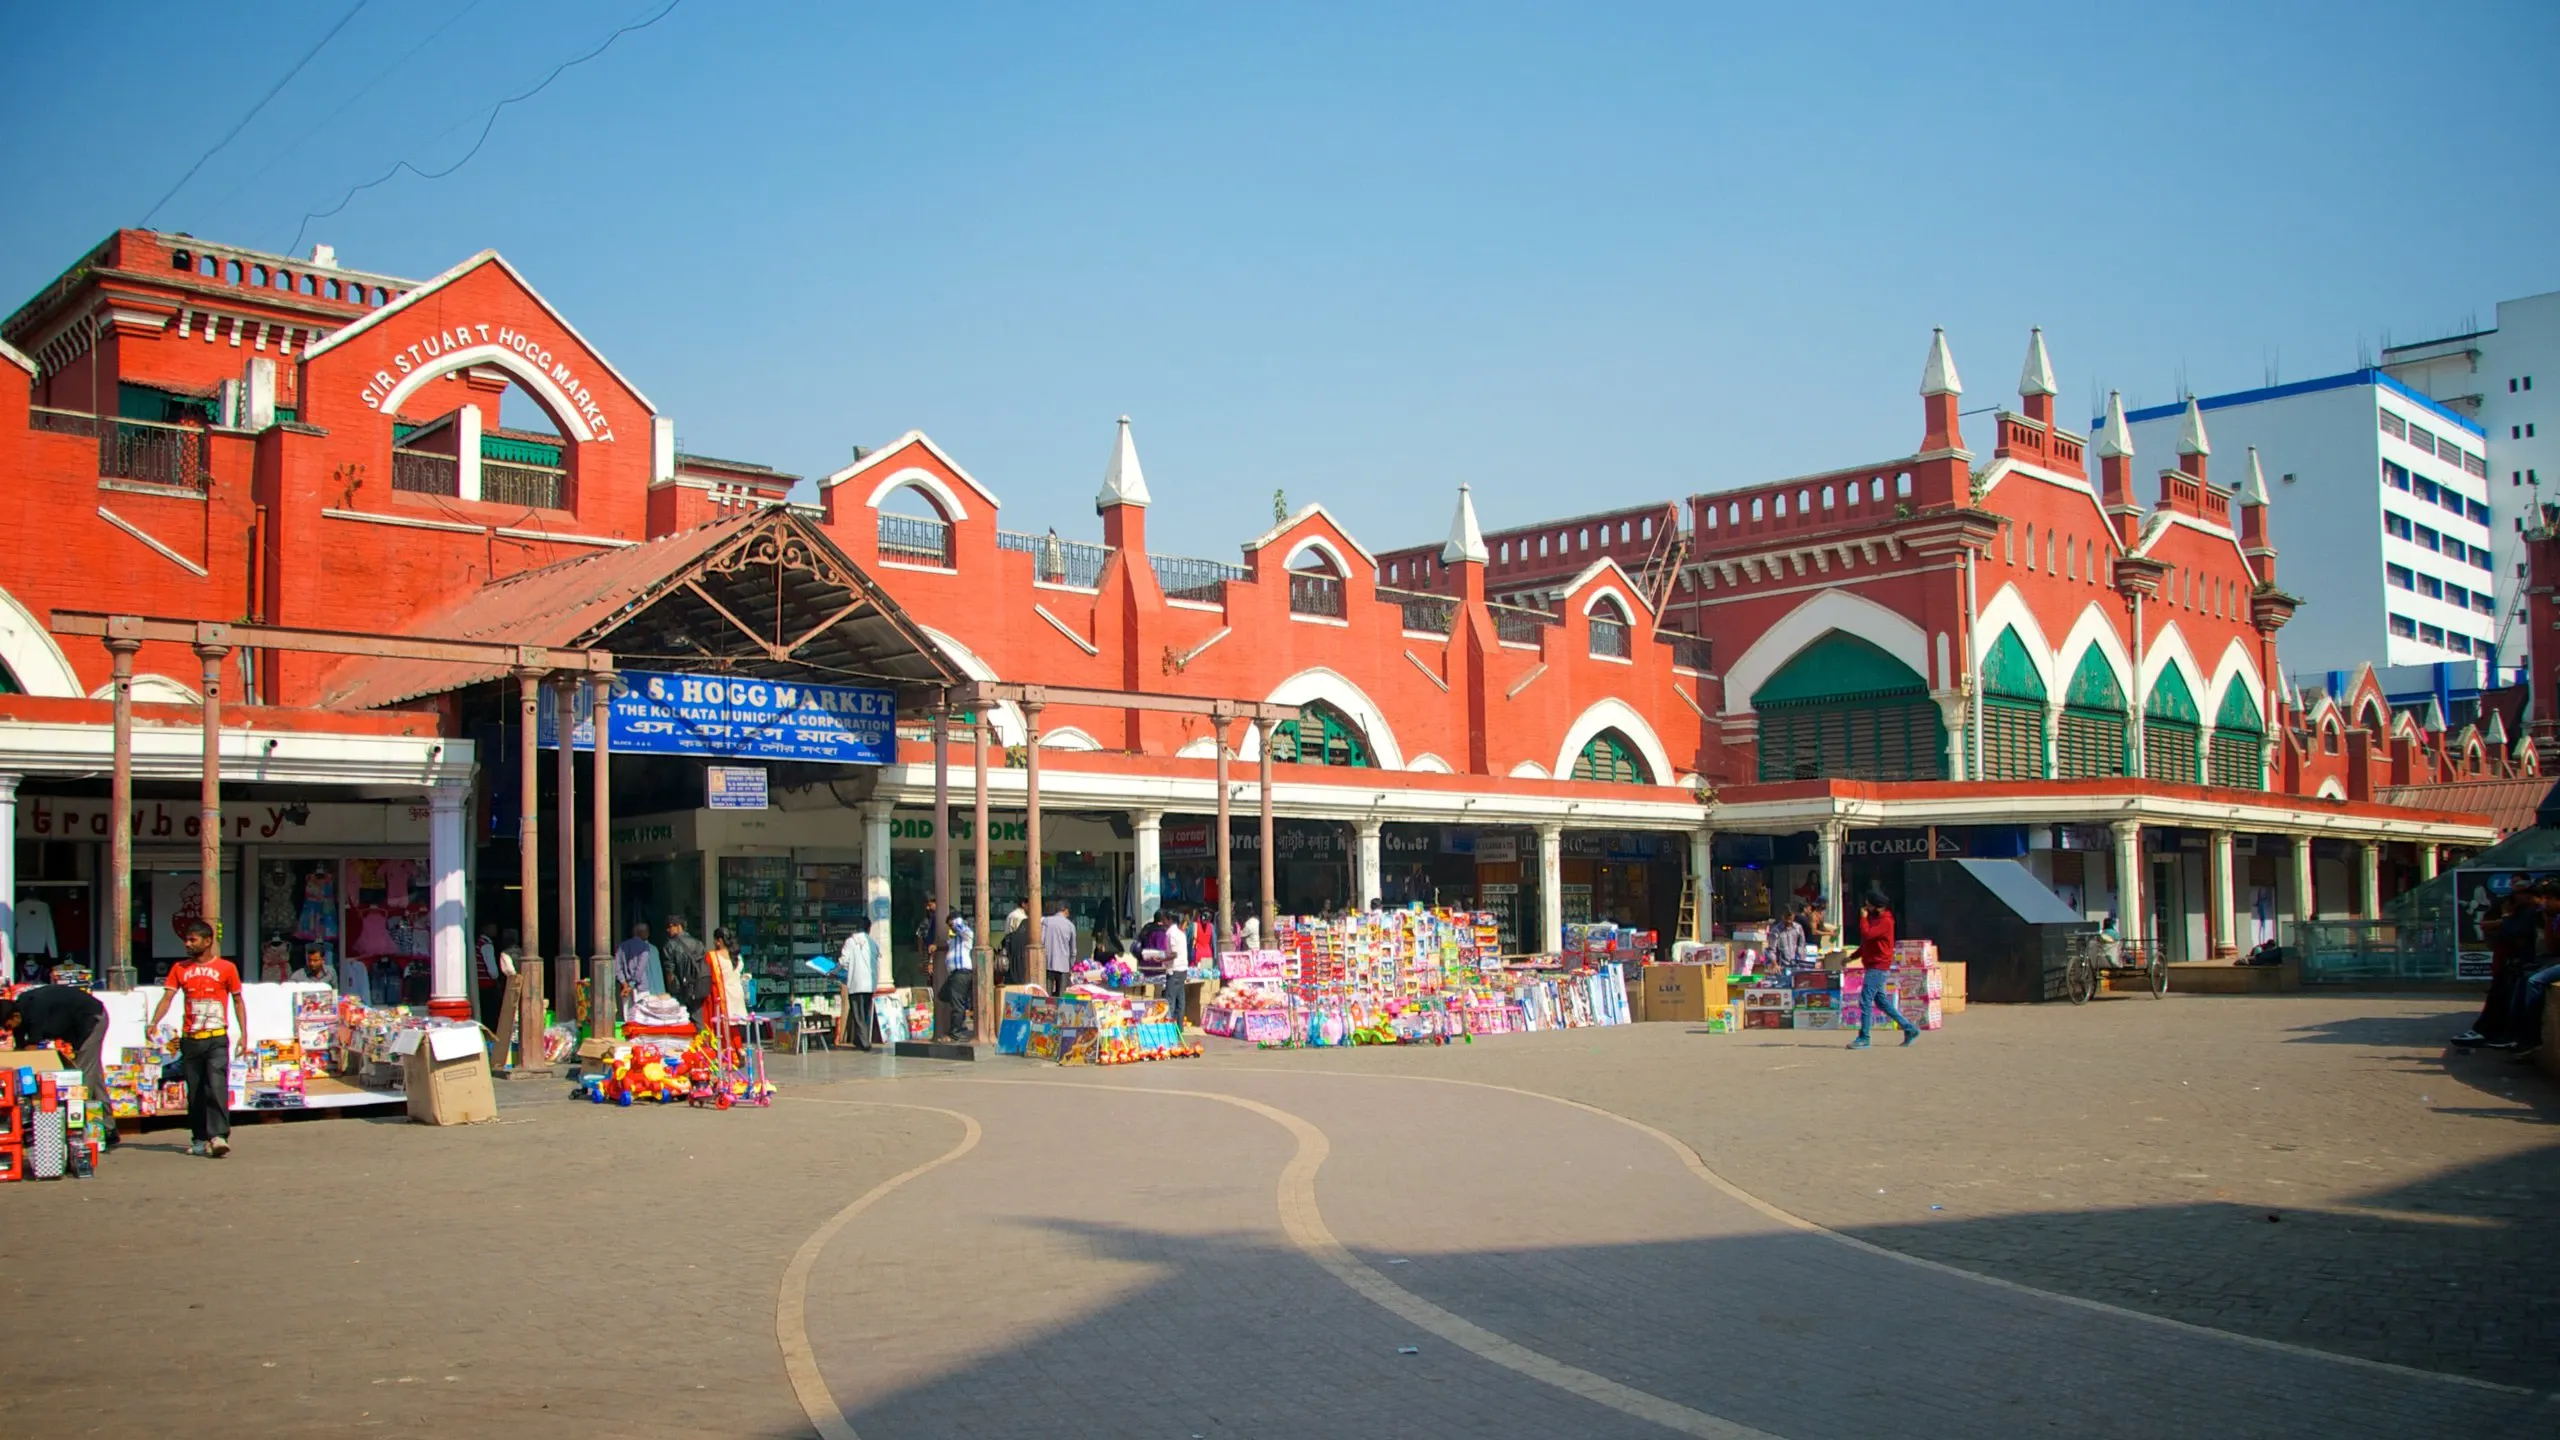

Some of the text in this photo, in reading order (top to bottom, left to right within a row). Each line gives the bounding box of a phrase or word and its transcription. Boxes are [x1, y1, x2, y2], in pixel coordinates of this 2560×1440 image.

[361, 323, 615, 443] SIR STUART HOGG MARKET
[612, 675, 894, 716] S. S. HOGG MARKET
[617, 703, 890, 732] THE KOLKATA MUNICIPAL CORPORATION
[15, 798, 284, 838] trabery
[1870, 838, 1929, 854] CARLO
